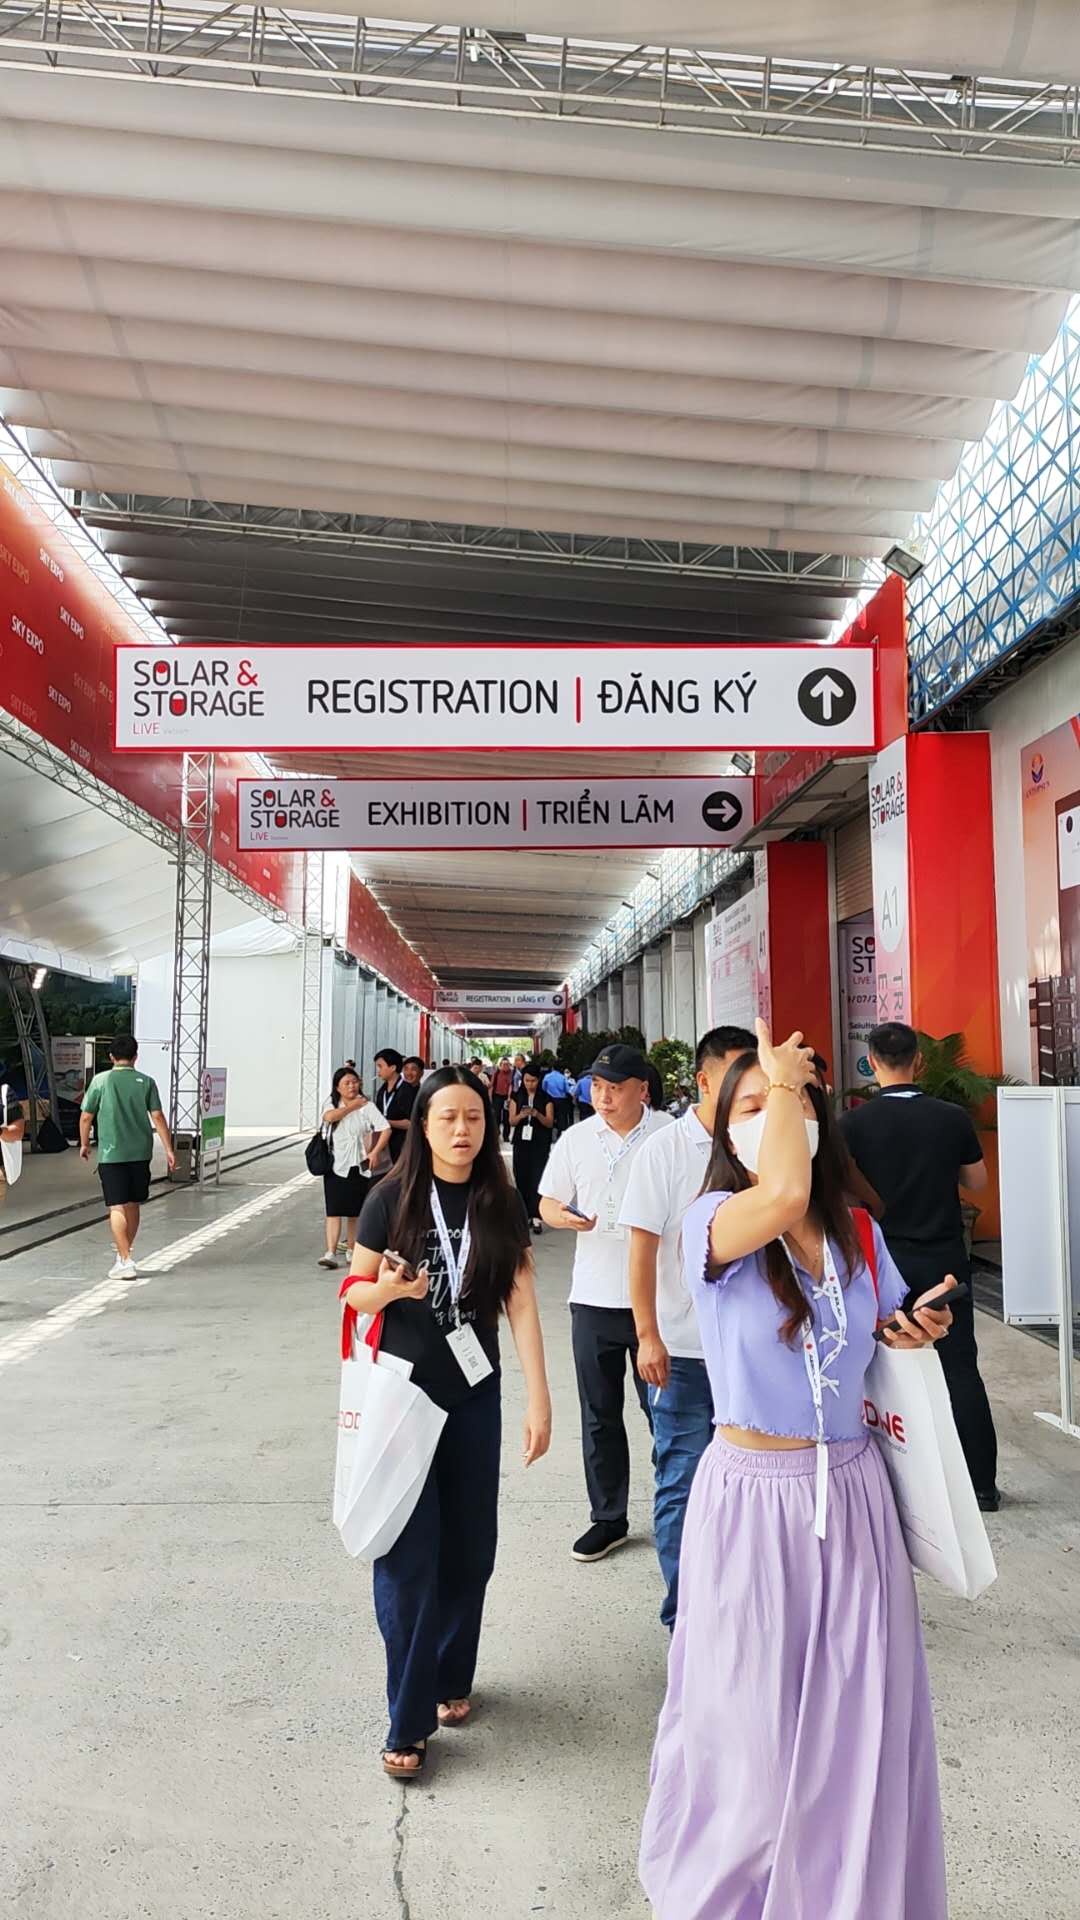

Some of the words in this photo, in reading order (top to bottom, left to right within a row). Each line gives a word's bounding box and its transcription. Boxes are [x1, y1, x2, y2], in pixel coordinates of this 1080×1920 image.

[40, 547, 50, 568] SKY
[50, 559, 64, 583] EXPO
[11, 615, 26, 638] SKY
[26, 628, 44, 655] EXPO
[60, 605, 71, 625] SKY
[70, 616, 84, 640] EXPO
[134, 660, 229, 687] SOLAR
[237, 660, 258, 687] &
[48, 685, 58, 702] SKY
[58, 693, 72, 713] EXPO
[134, 690, 265, 717] STORAGE
[308, 679, 558, 713] REGISTRATION
[597, 672, 699, 713] ĐĂNG
[714, 671, 757, 713] KÝ
[133, 722, 160, 734] LIVE
[250, 789, 316, 808] SOLAR
[320, 789, 336, 808] &
[871, 776, 896, 807] SOLAR
[896, 771, 903, 793] &
[250, 810, 340, 828] STORAGE
[368, 799, 510, 826] EXHIBITION
[536, 788, 610, 825] TRIỂN
[620, 794, 674, 824] LÃM
[872, 793, 905, 829] STORAGE
[250, 832, 269, 841] LIVE
[881, 886, 899, 930] A1
